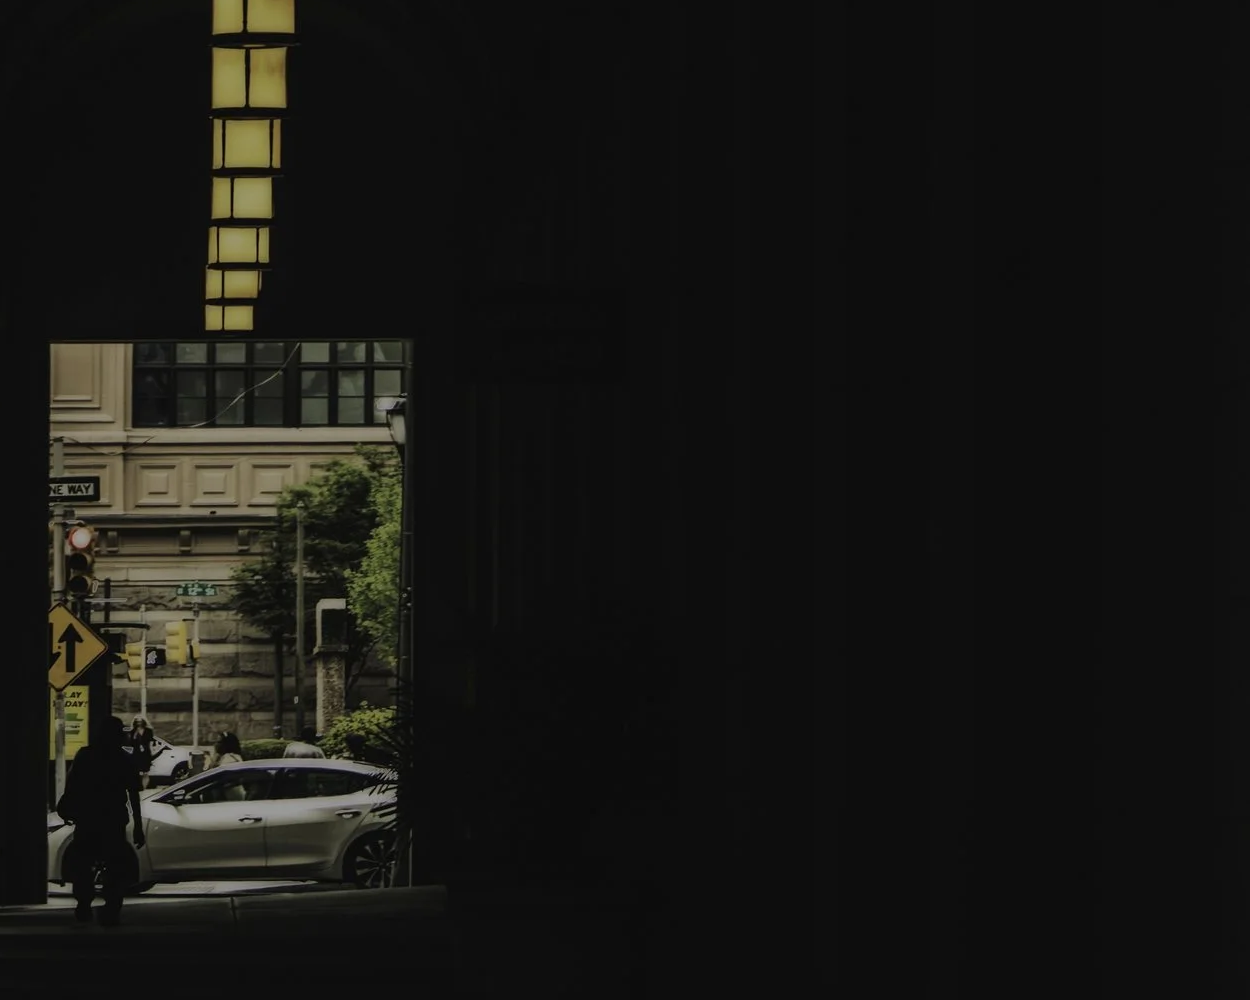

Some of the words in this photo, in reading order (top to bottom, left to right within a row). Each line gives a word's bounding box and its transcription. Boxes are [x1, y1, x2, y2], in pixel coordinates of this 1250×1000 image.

[49, 484, 63, 495] NE
[67, 484, 91, 495] WAY
[53, 700, 88, 708] DAY!
